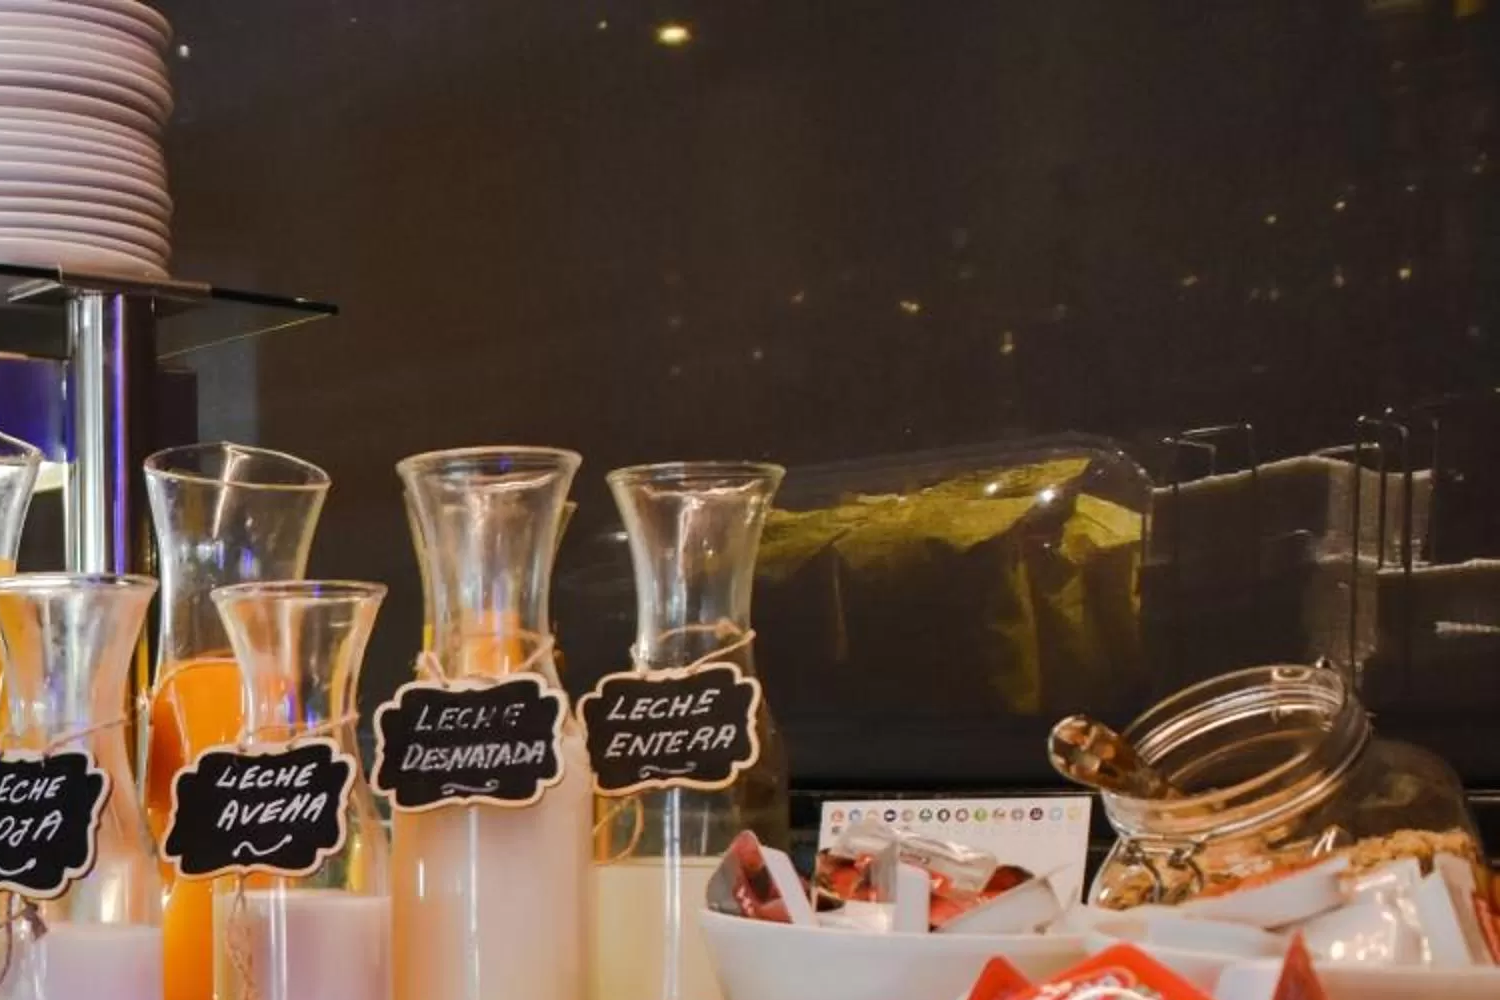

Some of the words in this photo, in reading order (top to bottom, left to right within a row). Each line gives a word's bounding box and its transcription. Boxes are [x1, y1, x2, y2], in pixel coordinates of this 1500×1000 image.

[415, 704, 524, 731] LECHE
[607, 689, 719, 720] LECHE
[401, 741, 545, 772] DESNATADA
[605, 725, 736, 757] ENTERA
[216, 763, 316, 789] LECHE
[217, 793, 327, 830] AVENA
